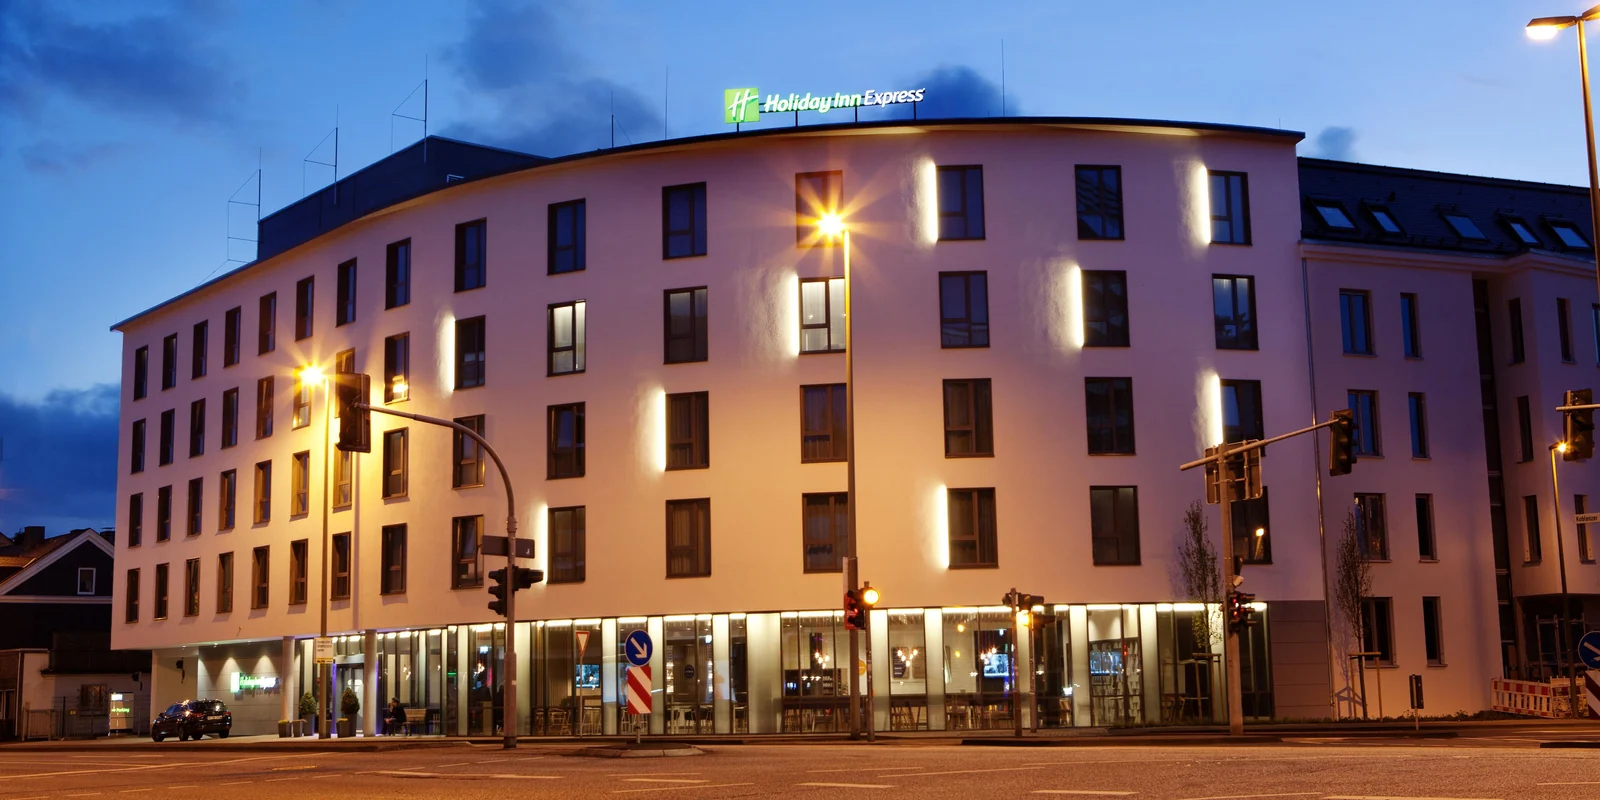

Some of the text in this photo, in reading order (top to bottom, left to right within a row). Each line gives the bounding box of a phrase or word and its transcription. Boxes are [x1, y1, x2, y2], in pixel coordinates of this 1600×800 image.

[763, 88, 925, 113] Holiday Inn Express
